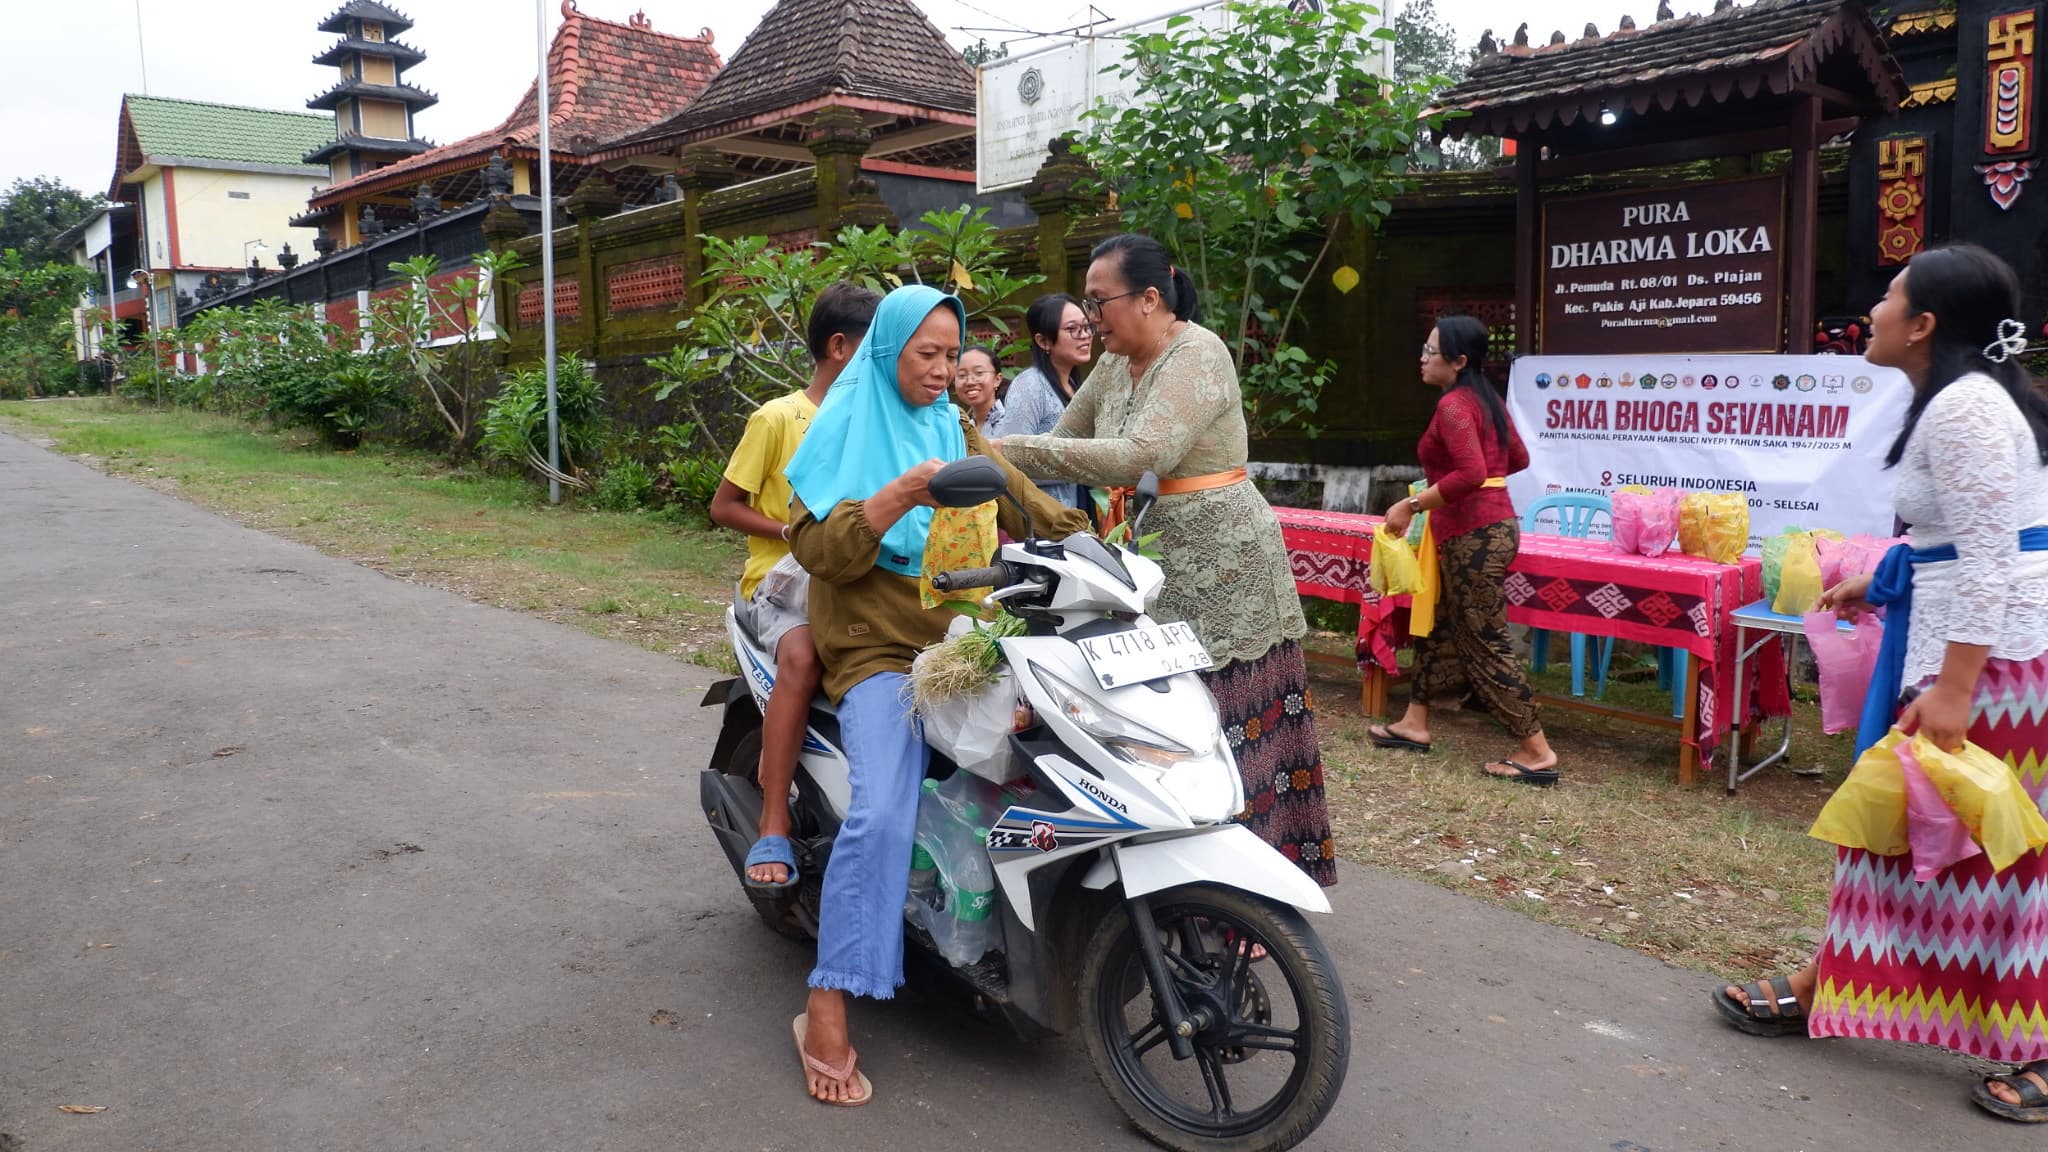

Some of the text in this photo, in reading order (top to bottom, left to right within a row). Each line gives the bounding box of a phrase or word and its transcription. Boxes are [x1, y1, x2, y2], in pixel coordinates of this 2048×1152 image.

[1623, 201, 1690, 228] PURA
[1551, 225, 1772, 269] DHARMA LOKA
[1687, 273, 1709, 286] Ds.
[1714, 269, 1762, 285] Plajan
[1564, 302, 1589, 315] Kec.
[1592, 300, 1624, 313] Pakis
[1629, 298, 1647, 314] Aji
[1720, 292, 1762, 306] 59456
[1546, 399, 1850, 438] SAKA BHOGA SEVANAM
[1539, 431, 1852, 450] PANITIA NASIONAL PERAYAAN HARI SUCI NYEPI TAHUN SAKA 1947/2025 M
[1617, 473, 1757, 492] SELURUH INDONESIA
[1774, 499, 1820, 511] SELESAI
[1083, 624, 1196, 661] K 4718 APC
[1079, 777, 1129, 815] HONDA
